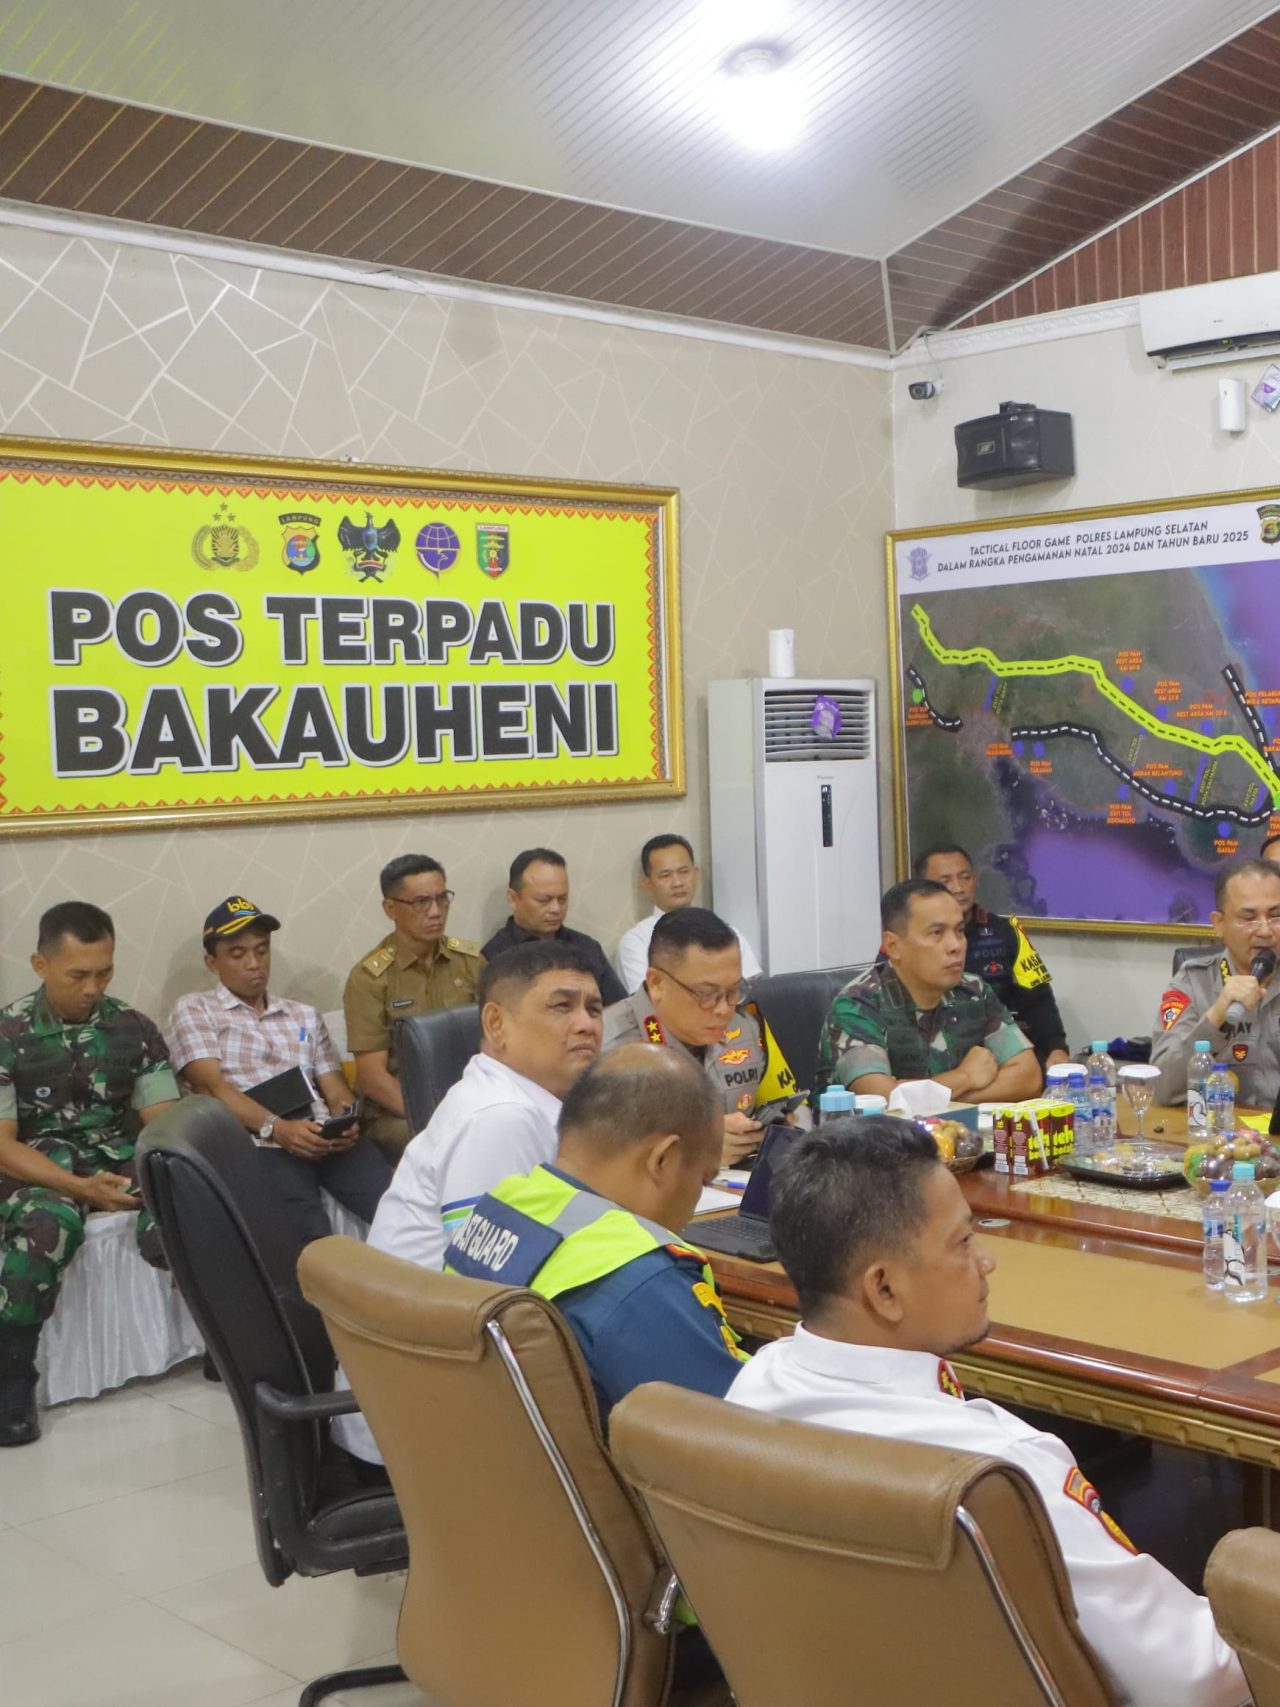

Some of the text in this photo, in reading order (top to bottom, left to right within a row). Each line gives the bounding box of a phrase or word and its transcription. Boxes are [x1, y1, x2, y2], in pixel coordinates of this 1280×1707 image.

[280, 514, 320, 526] LAMPUNG
[970, 520, 1208, 556] TACTICAL FLOOR GAME POLRES LAMPUNG SELATAN
[937, 530, 1249, 572] DALAM RANGKA PENGAMANAN NATAL 2024 DAN TAHUN BARU 2025
[48, 588, 616, 667] POS TERPADU
[50, 681, 619, 777] BAKAUHENI
[725, 1067, 758, 1087] POLRI
